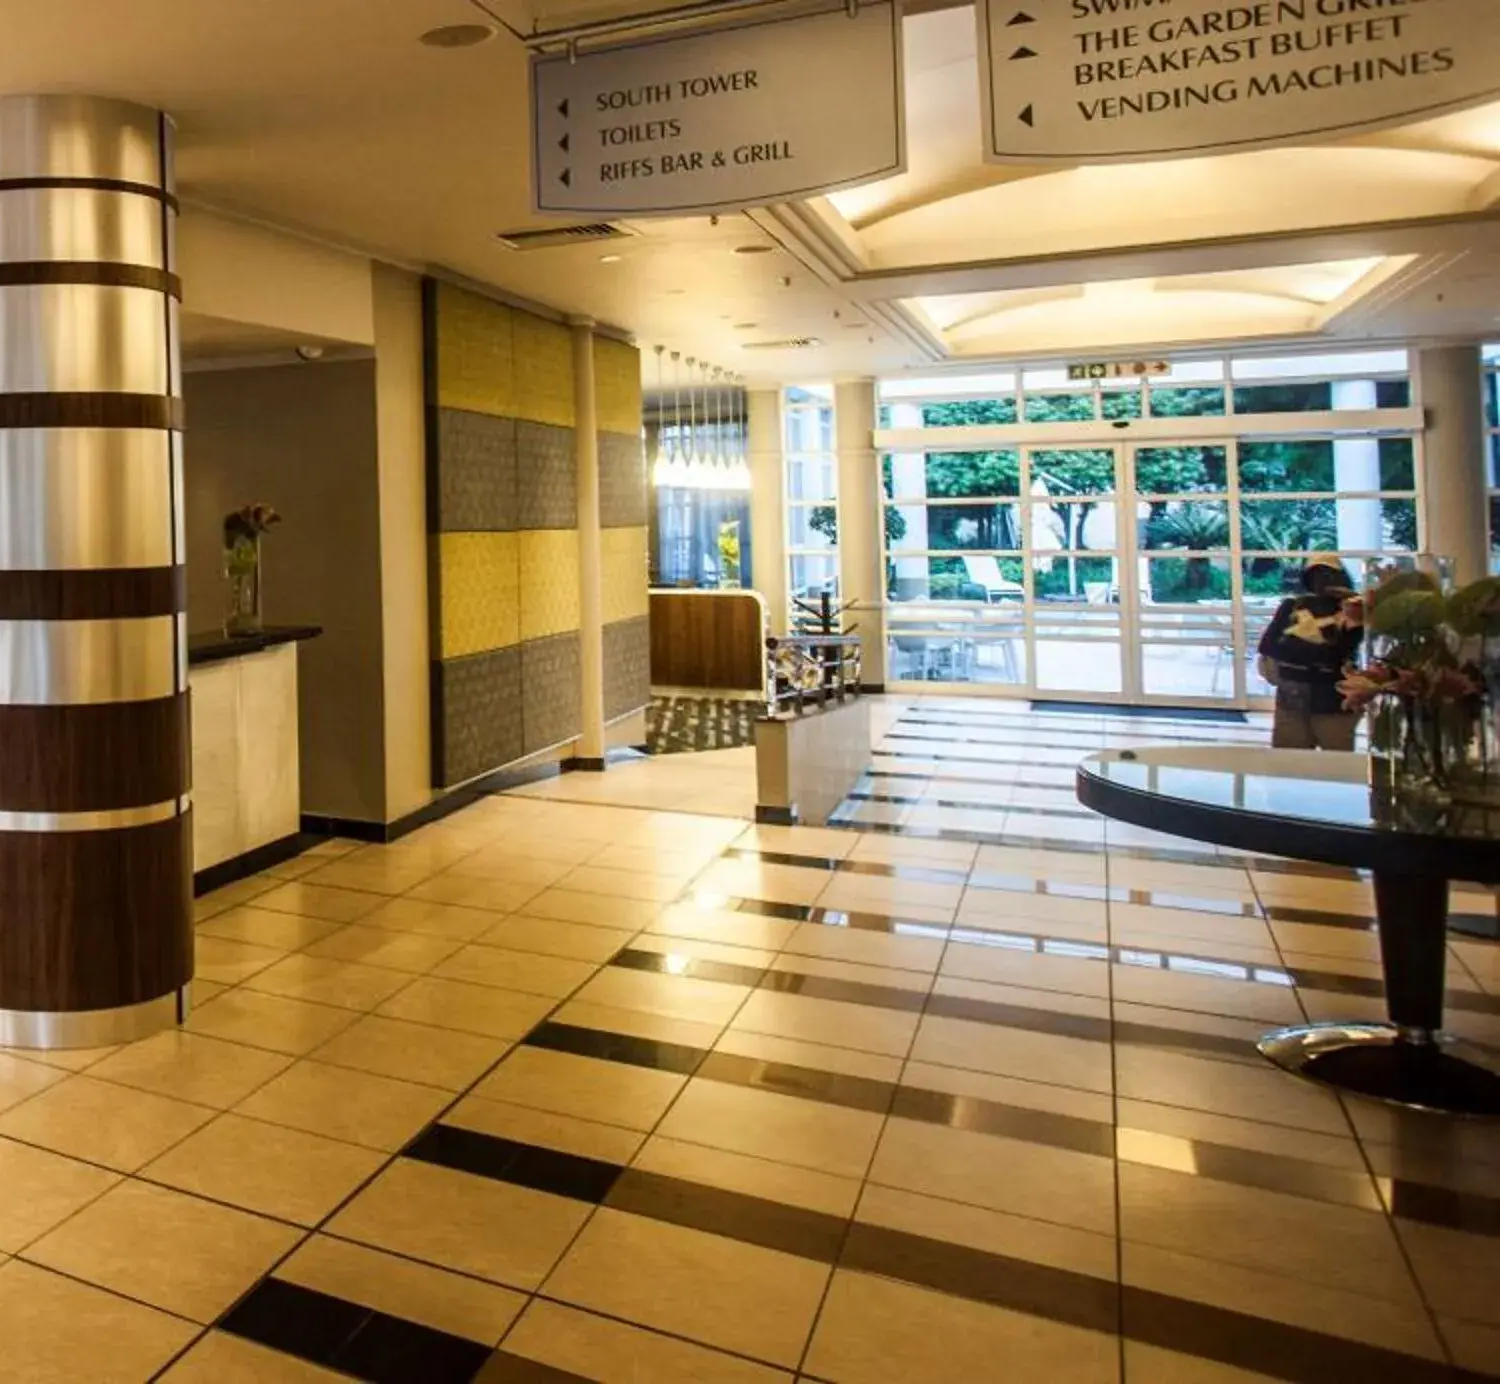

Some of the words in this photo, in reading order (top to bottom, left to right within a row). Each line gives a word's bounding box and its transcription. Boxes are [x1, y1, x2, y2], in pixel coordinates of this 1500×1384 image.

[1073, 25, 1139, 53] THE
[1148, 0, 1305, 43] GARDEN
[1075, 37, 1262, 85] BREAKFAST
[1271, 14, 1411, 55] BUFFET
[596, 84, 671, 112] SOUTH
[678, 69, 759, 99] TOWER
[1077, 79, 1237, 121] VENDING
[1247, 47, 1454, 98] MACHINES
[599, 118, 681, 147] TOILETS
[600, 157, 653, 182] RIFFS
[661, 150, 703, 175] BAR
[711, 150, 726, 168] &
[734, 141, 794, 165] GRILL
